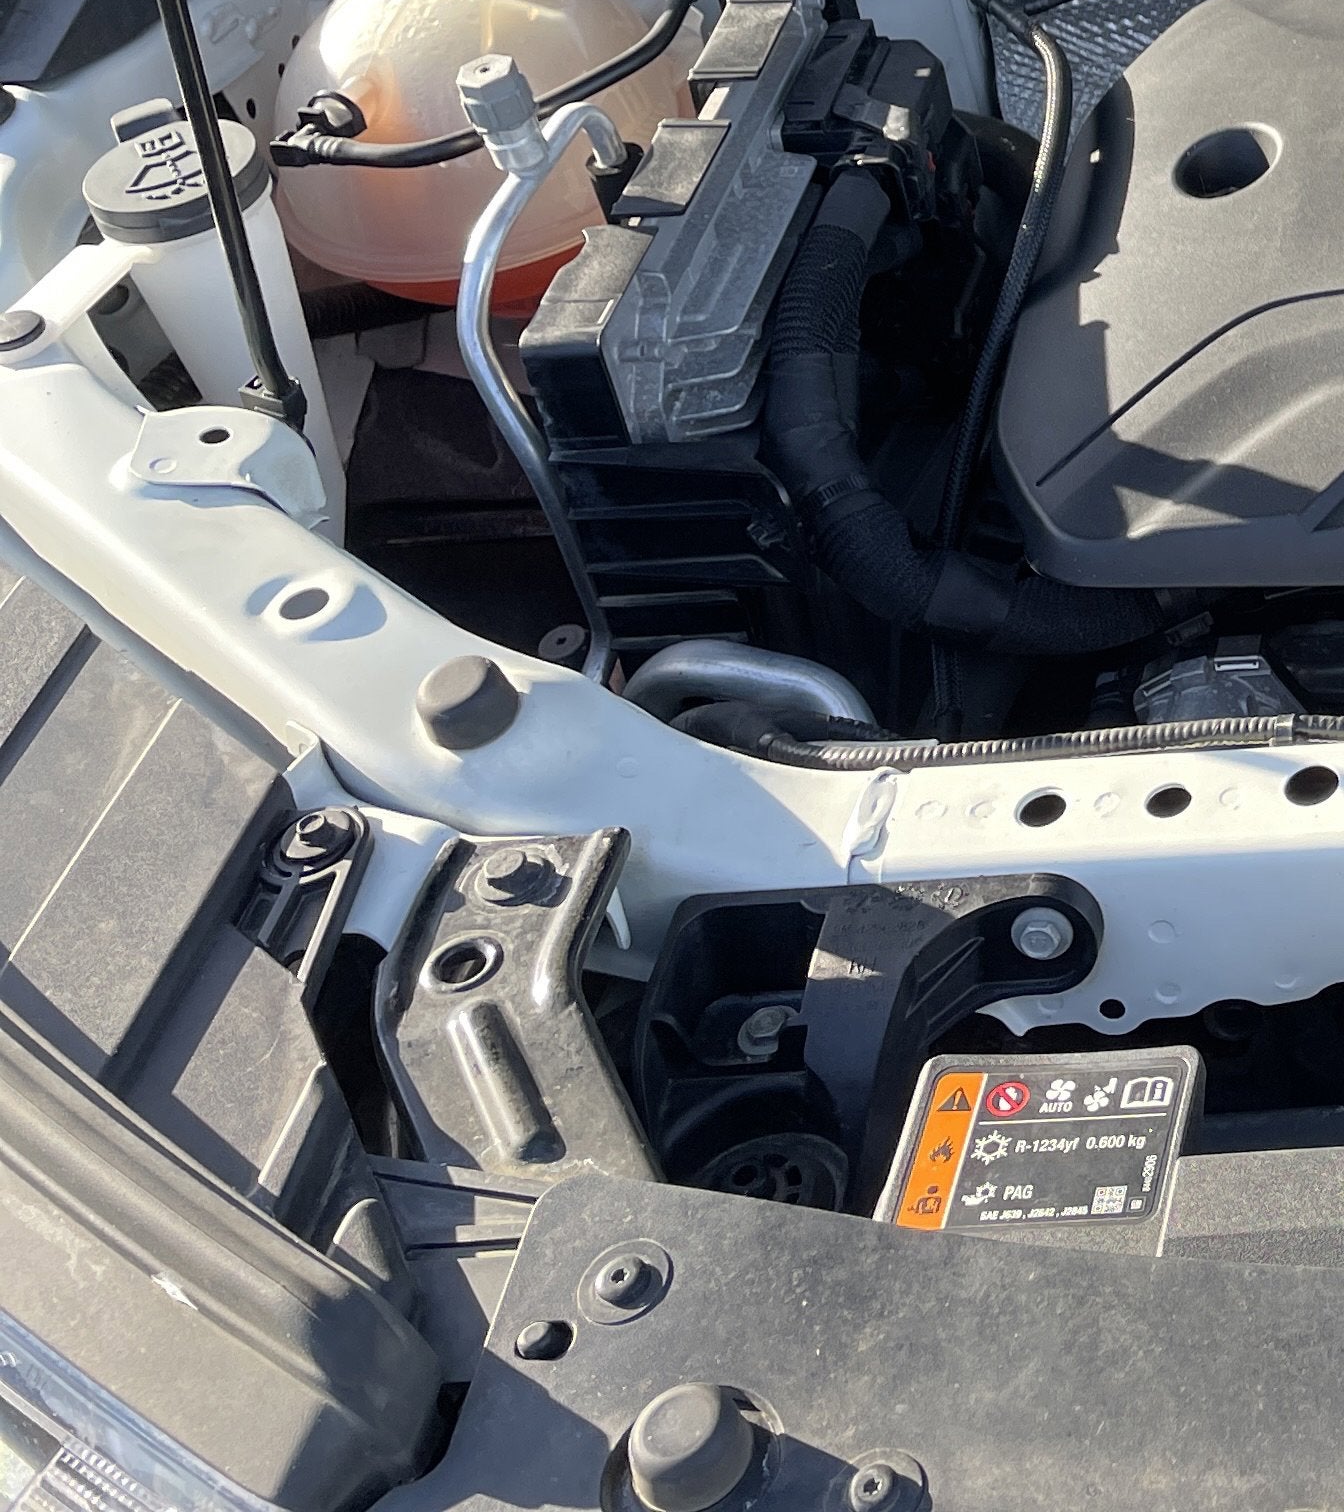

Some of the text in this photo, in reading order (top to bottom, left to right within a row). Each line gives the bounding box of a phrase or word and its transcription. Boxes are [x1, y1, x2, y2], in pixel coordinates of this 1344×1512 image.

[1039, 1101, 1072, 1113] AUTO
[1015, 1134, 1146, 1153] R-1234yf 0.600 kg
[1003, 1185, 1033, 1200] PAG
[980, 1210, 998, 1221] SAE
